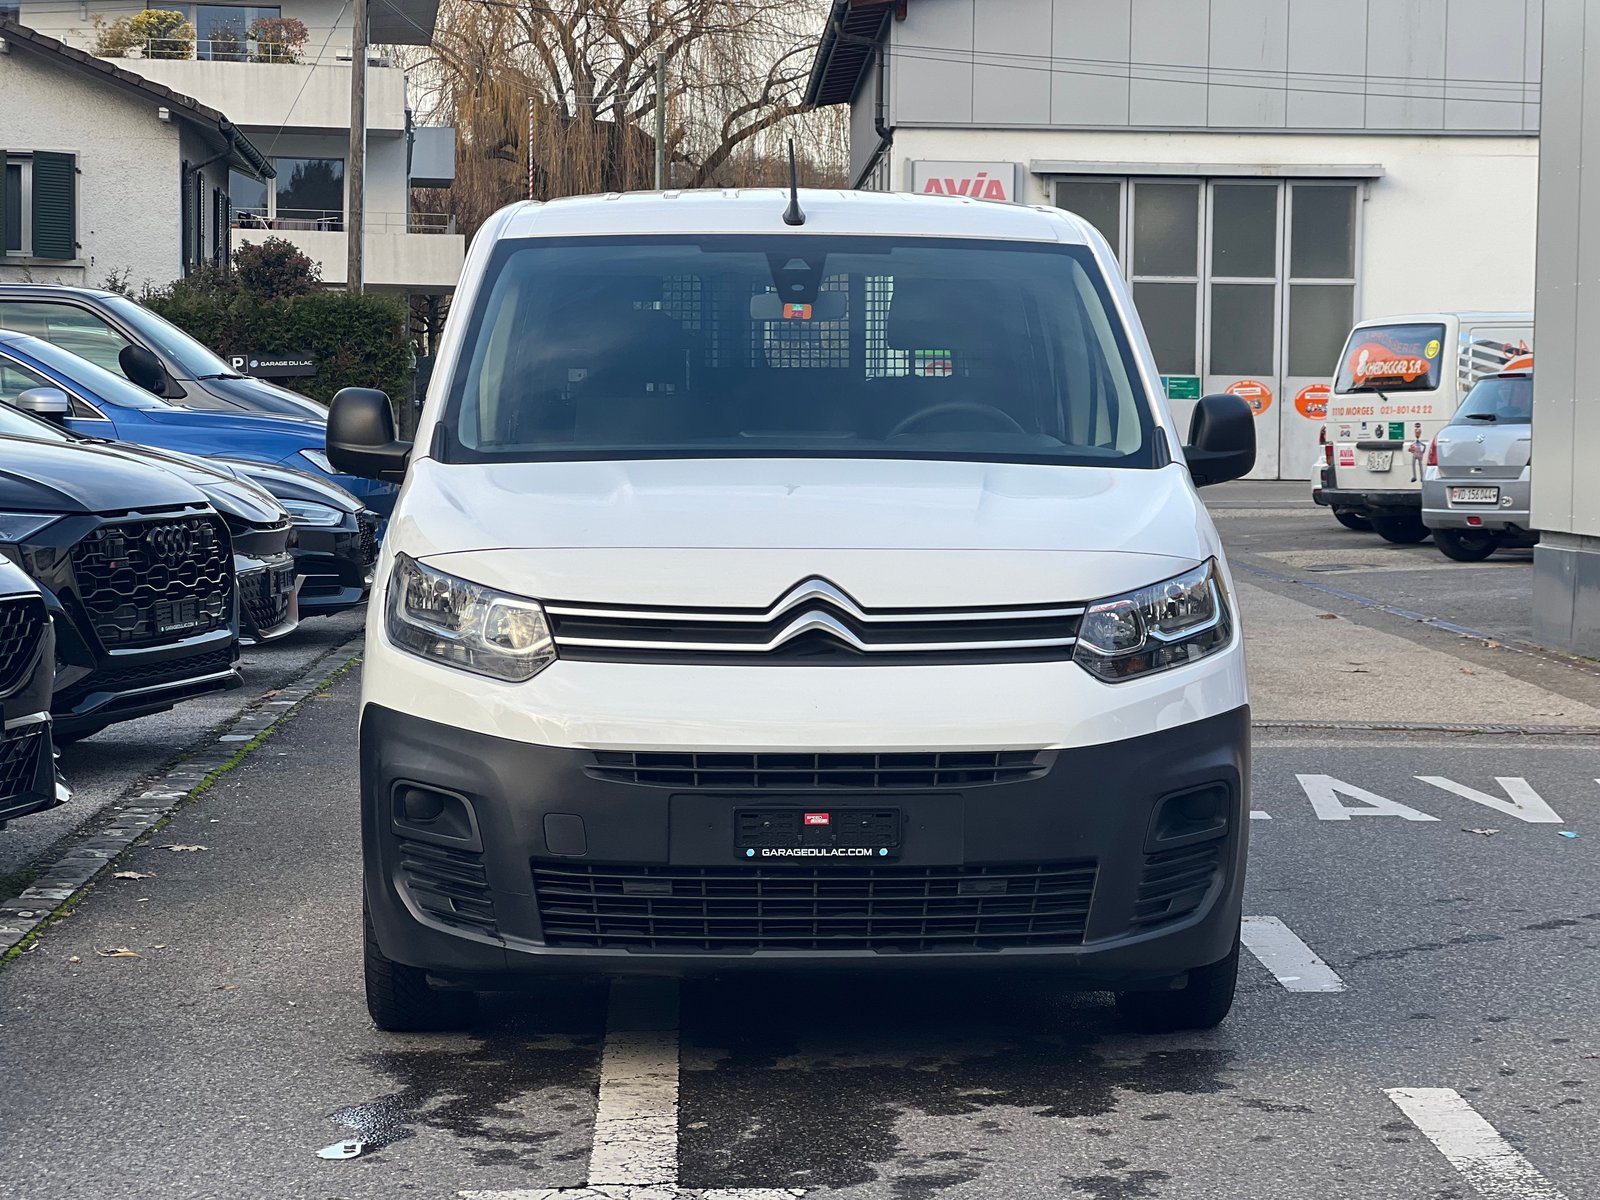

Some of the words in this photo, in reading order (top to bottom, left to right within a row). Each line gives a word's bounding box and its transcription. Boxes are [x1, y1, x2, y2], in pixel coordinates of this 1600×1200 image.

[924, 172, 1006, 200] AVIA
[232, 357, 244, 370] P
[1332, 407, 1344, 416] 1110
[1345, 406, 1374, 416] MORGES
[1340, 448, 1354, 457] AVIA
[1250, 774, 1600, 823] AV
[761, 848, 873, 857] GARAGEDULAC.COM
